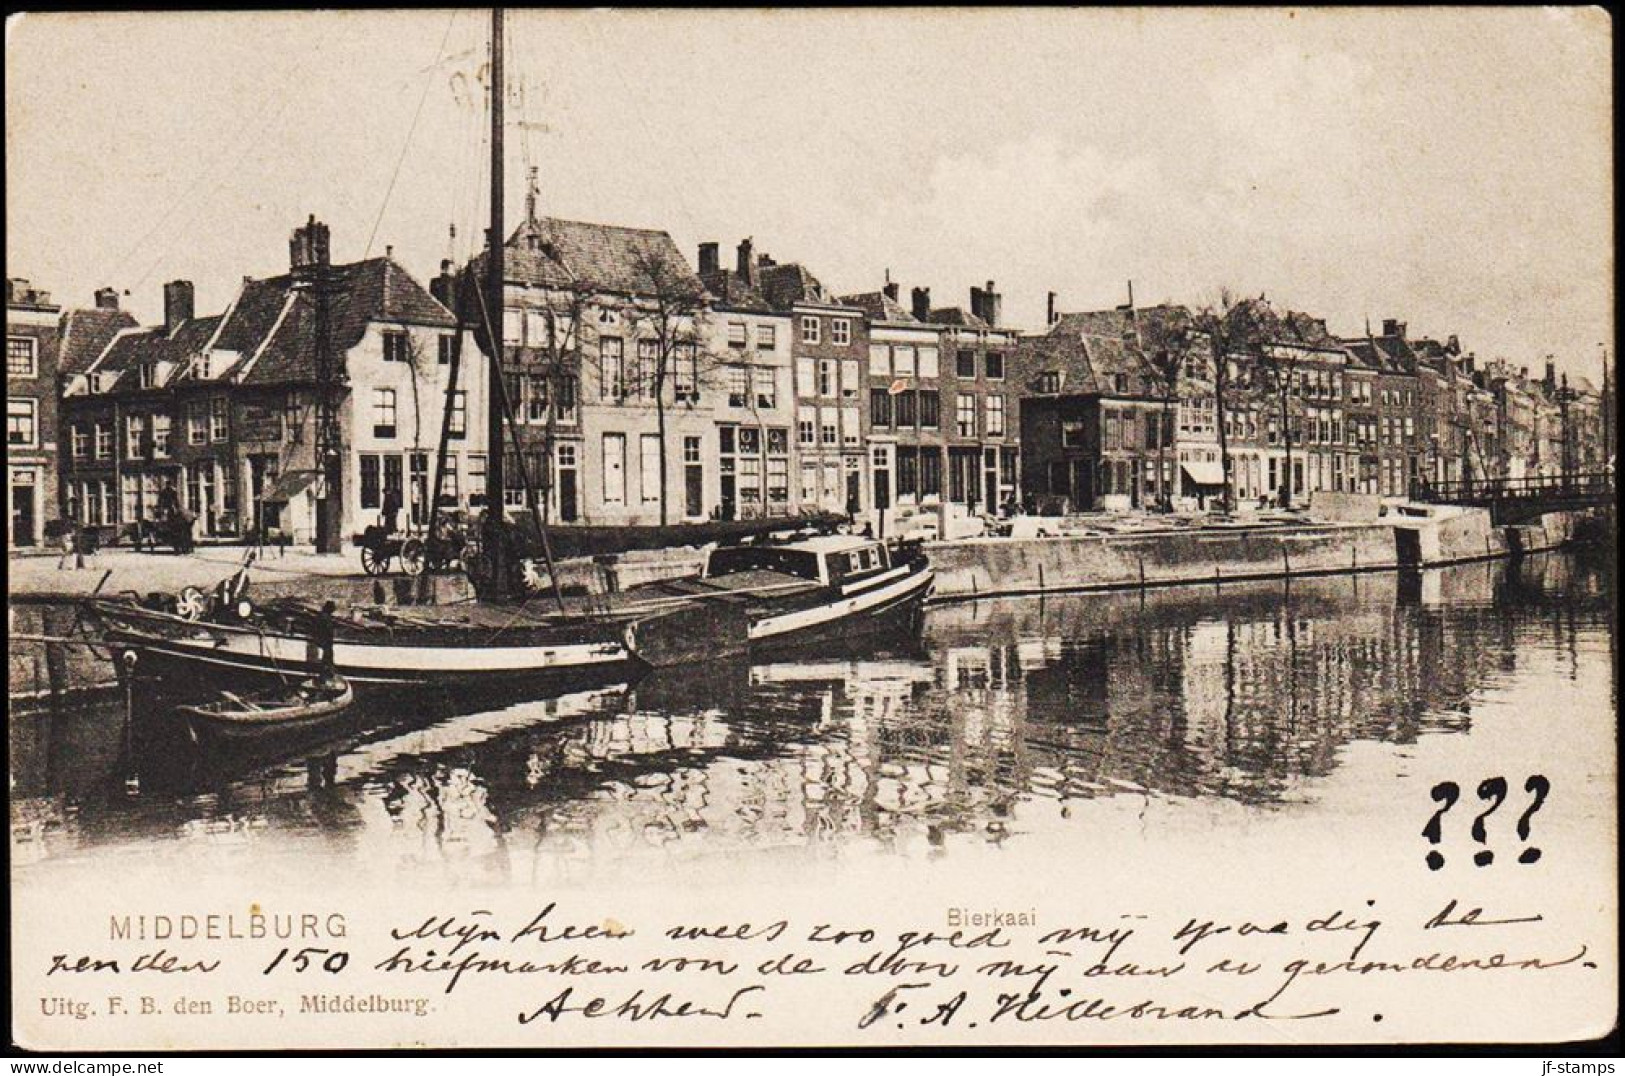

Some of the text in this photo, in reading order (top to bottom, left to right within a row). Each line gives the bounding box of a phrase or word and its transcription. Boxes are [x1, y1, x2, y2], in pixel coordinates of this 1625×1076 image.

[110, 914, 347, 939] MIDDELBURG
[948, 907, 1037, 926] Bierkaai
[263, 947, 349, 975] 150
[40, 994, 437, 1020] Uitg. F. B. den Boer, Middelburg.
